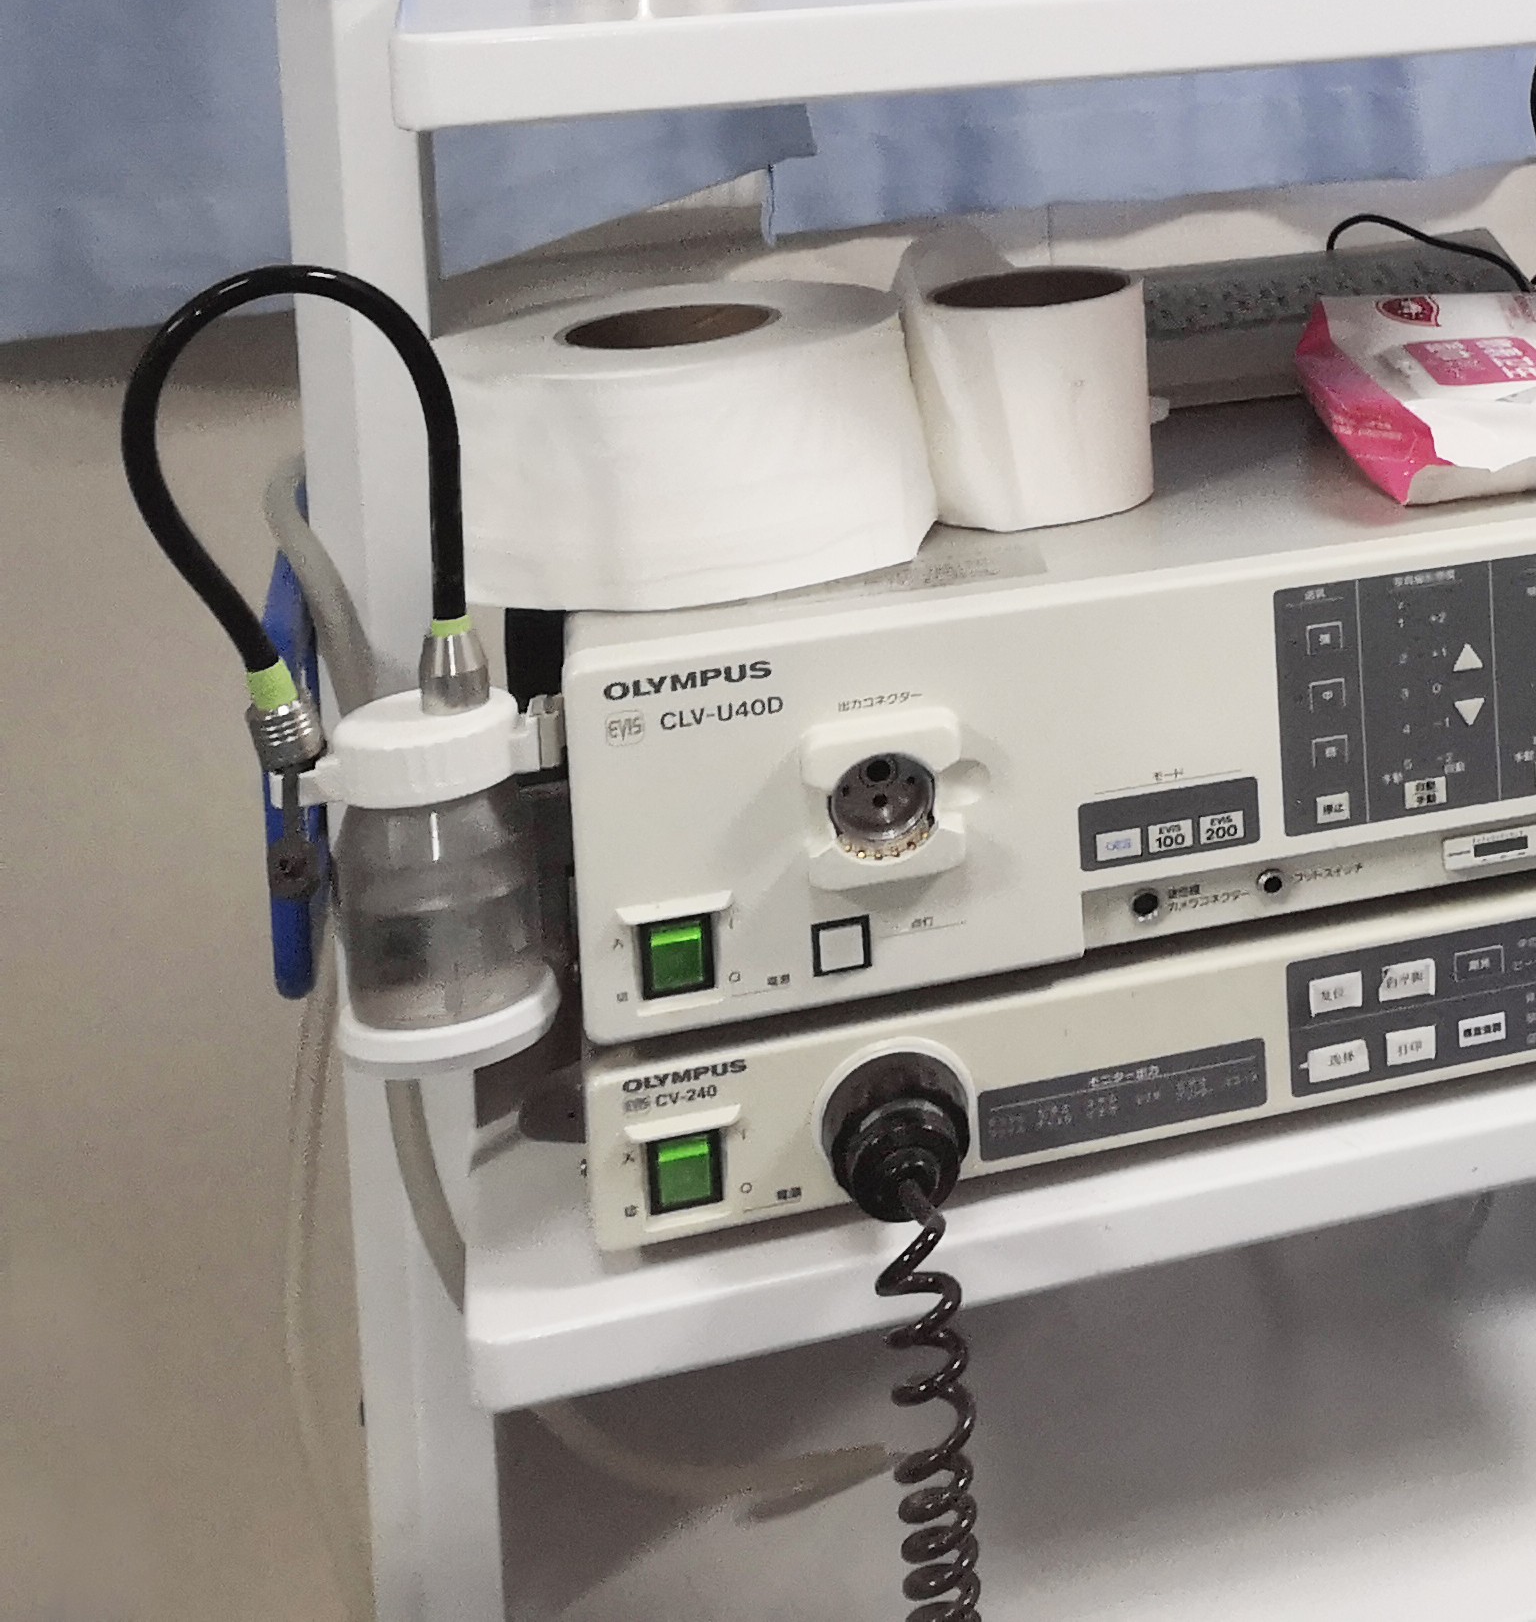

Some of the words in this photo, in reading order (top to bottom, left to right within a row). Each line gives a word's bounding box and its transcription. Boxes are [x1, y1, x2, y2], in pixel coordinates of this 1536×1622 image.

[603, 661, 772, 701] OLYMPUS
[660, 697, 784, 730] CLV-U40D
[1156, 834, 1185, 849] 100
[1206, 824, 1238, 841] 200
[623, 1059, 748, 1093] OLYMPUS
[655, 1084, 718, 1108] CV-240
